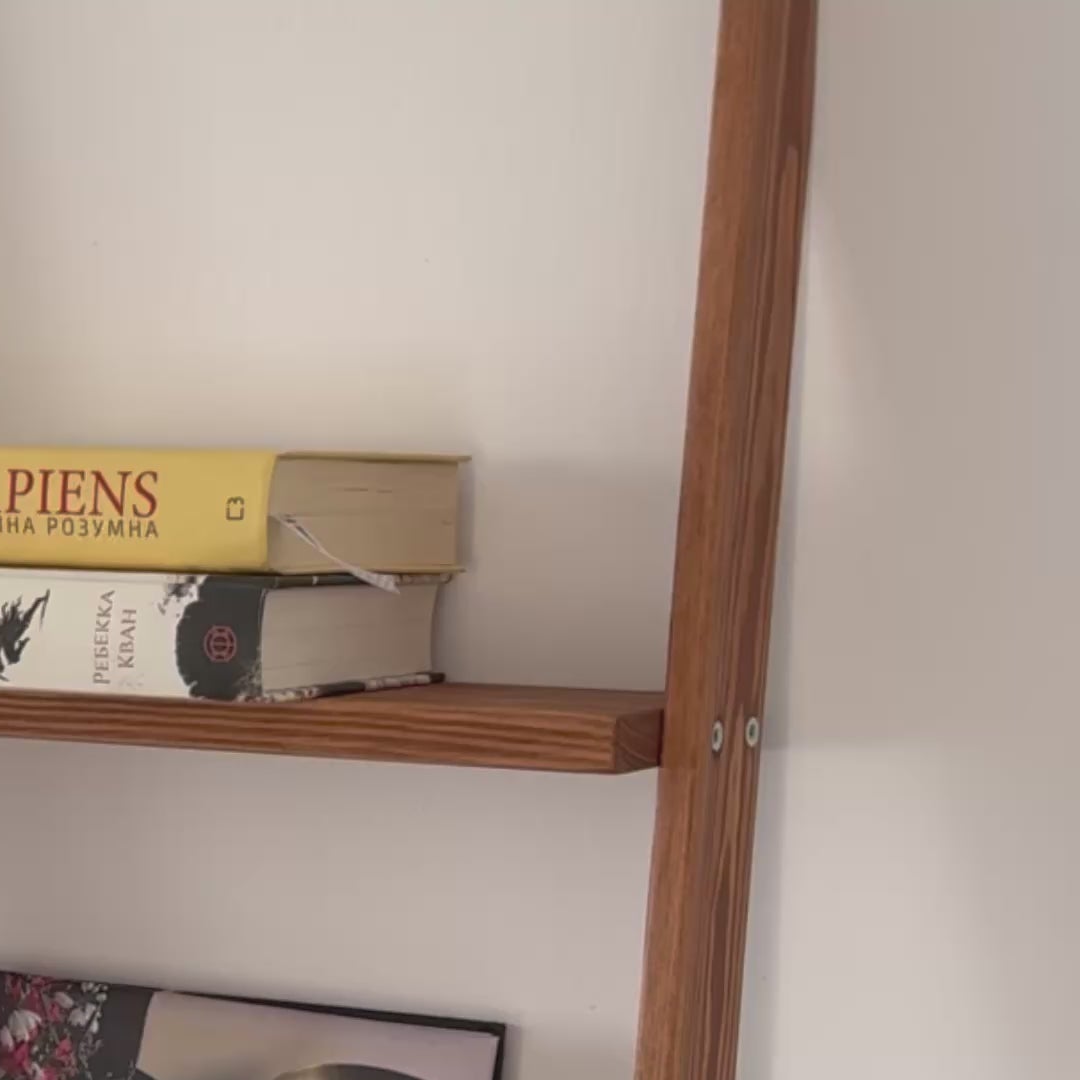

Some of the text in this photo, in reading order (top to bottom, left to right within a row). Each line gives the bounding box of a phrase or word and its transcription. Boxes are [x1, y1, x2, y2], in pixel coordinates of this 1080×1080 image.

[47, 516, 159, 540] РОЗУМНА
[92, 589, 115, 685] РЕБЕККА
[117, 609, 137, 669] КВАН
